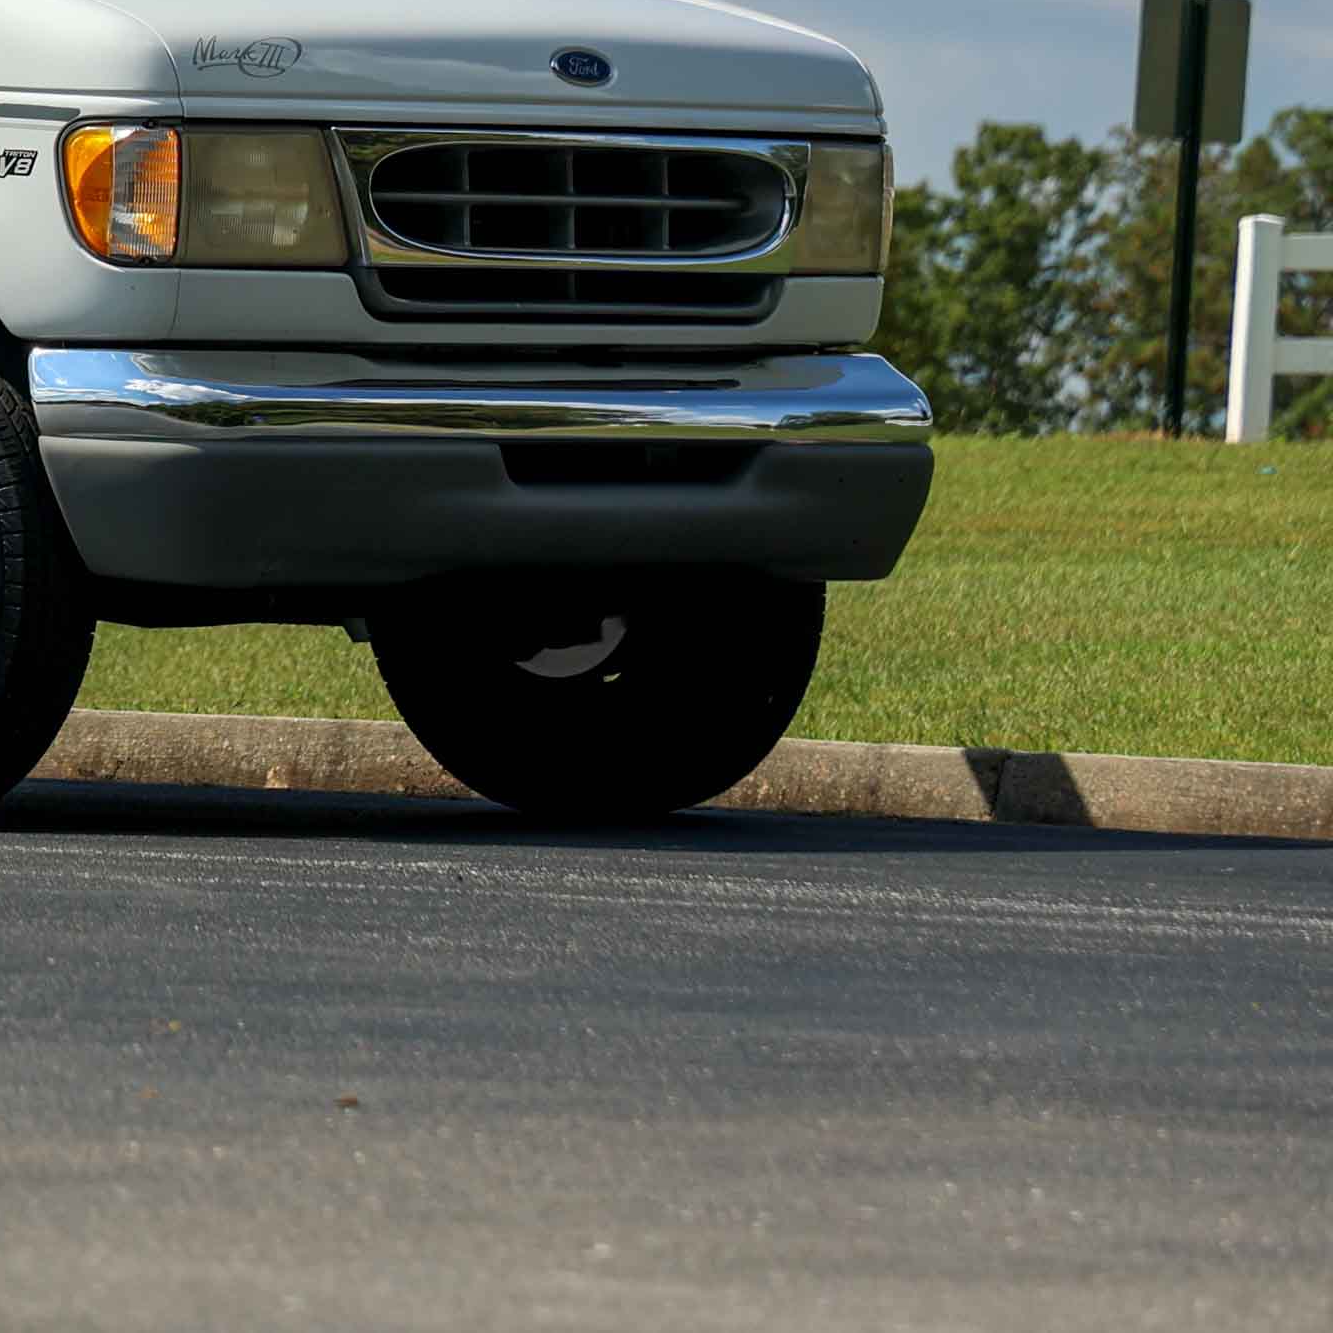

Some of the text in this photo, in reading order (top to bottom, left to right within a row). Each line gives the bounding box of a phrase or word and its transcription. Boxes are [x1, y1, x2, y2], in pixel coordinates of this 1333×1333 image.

[192, 33, 258, 66] Mark
[568, 57, 598, 75] Ford
[0, 156, 32, 176] V8
